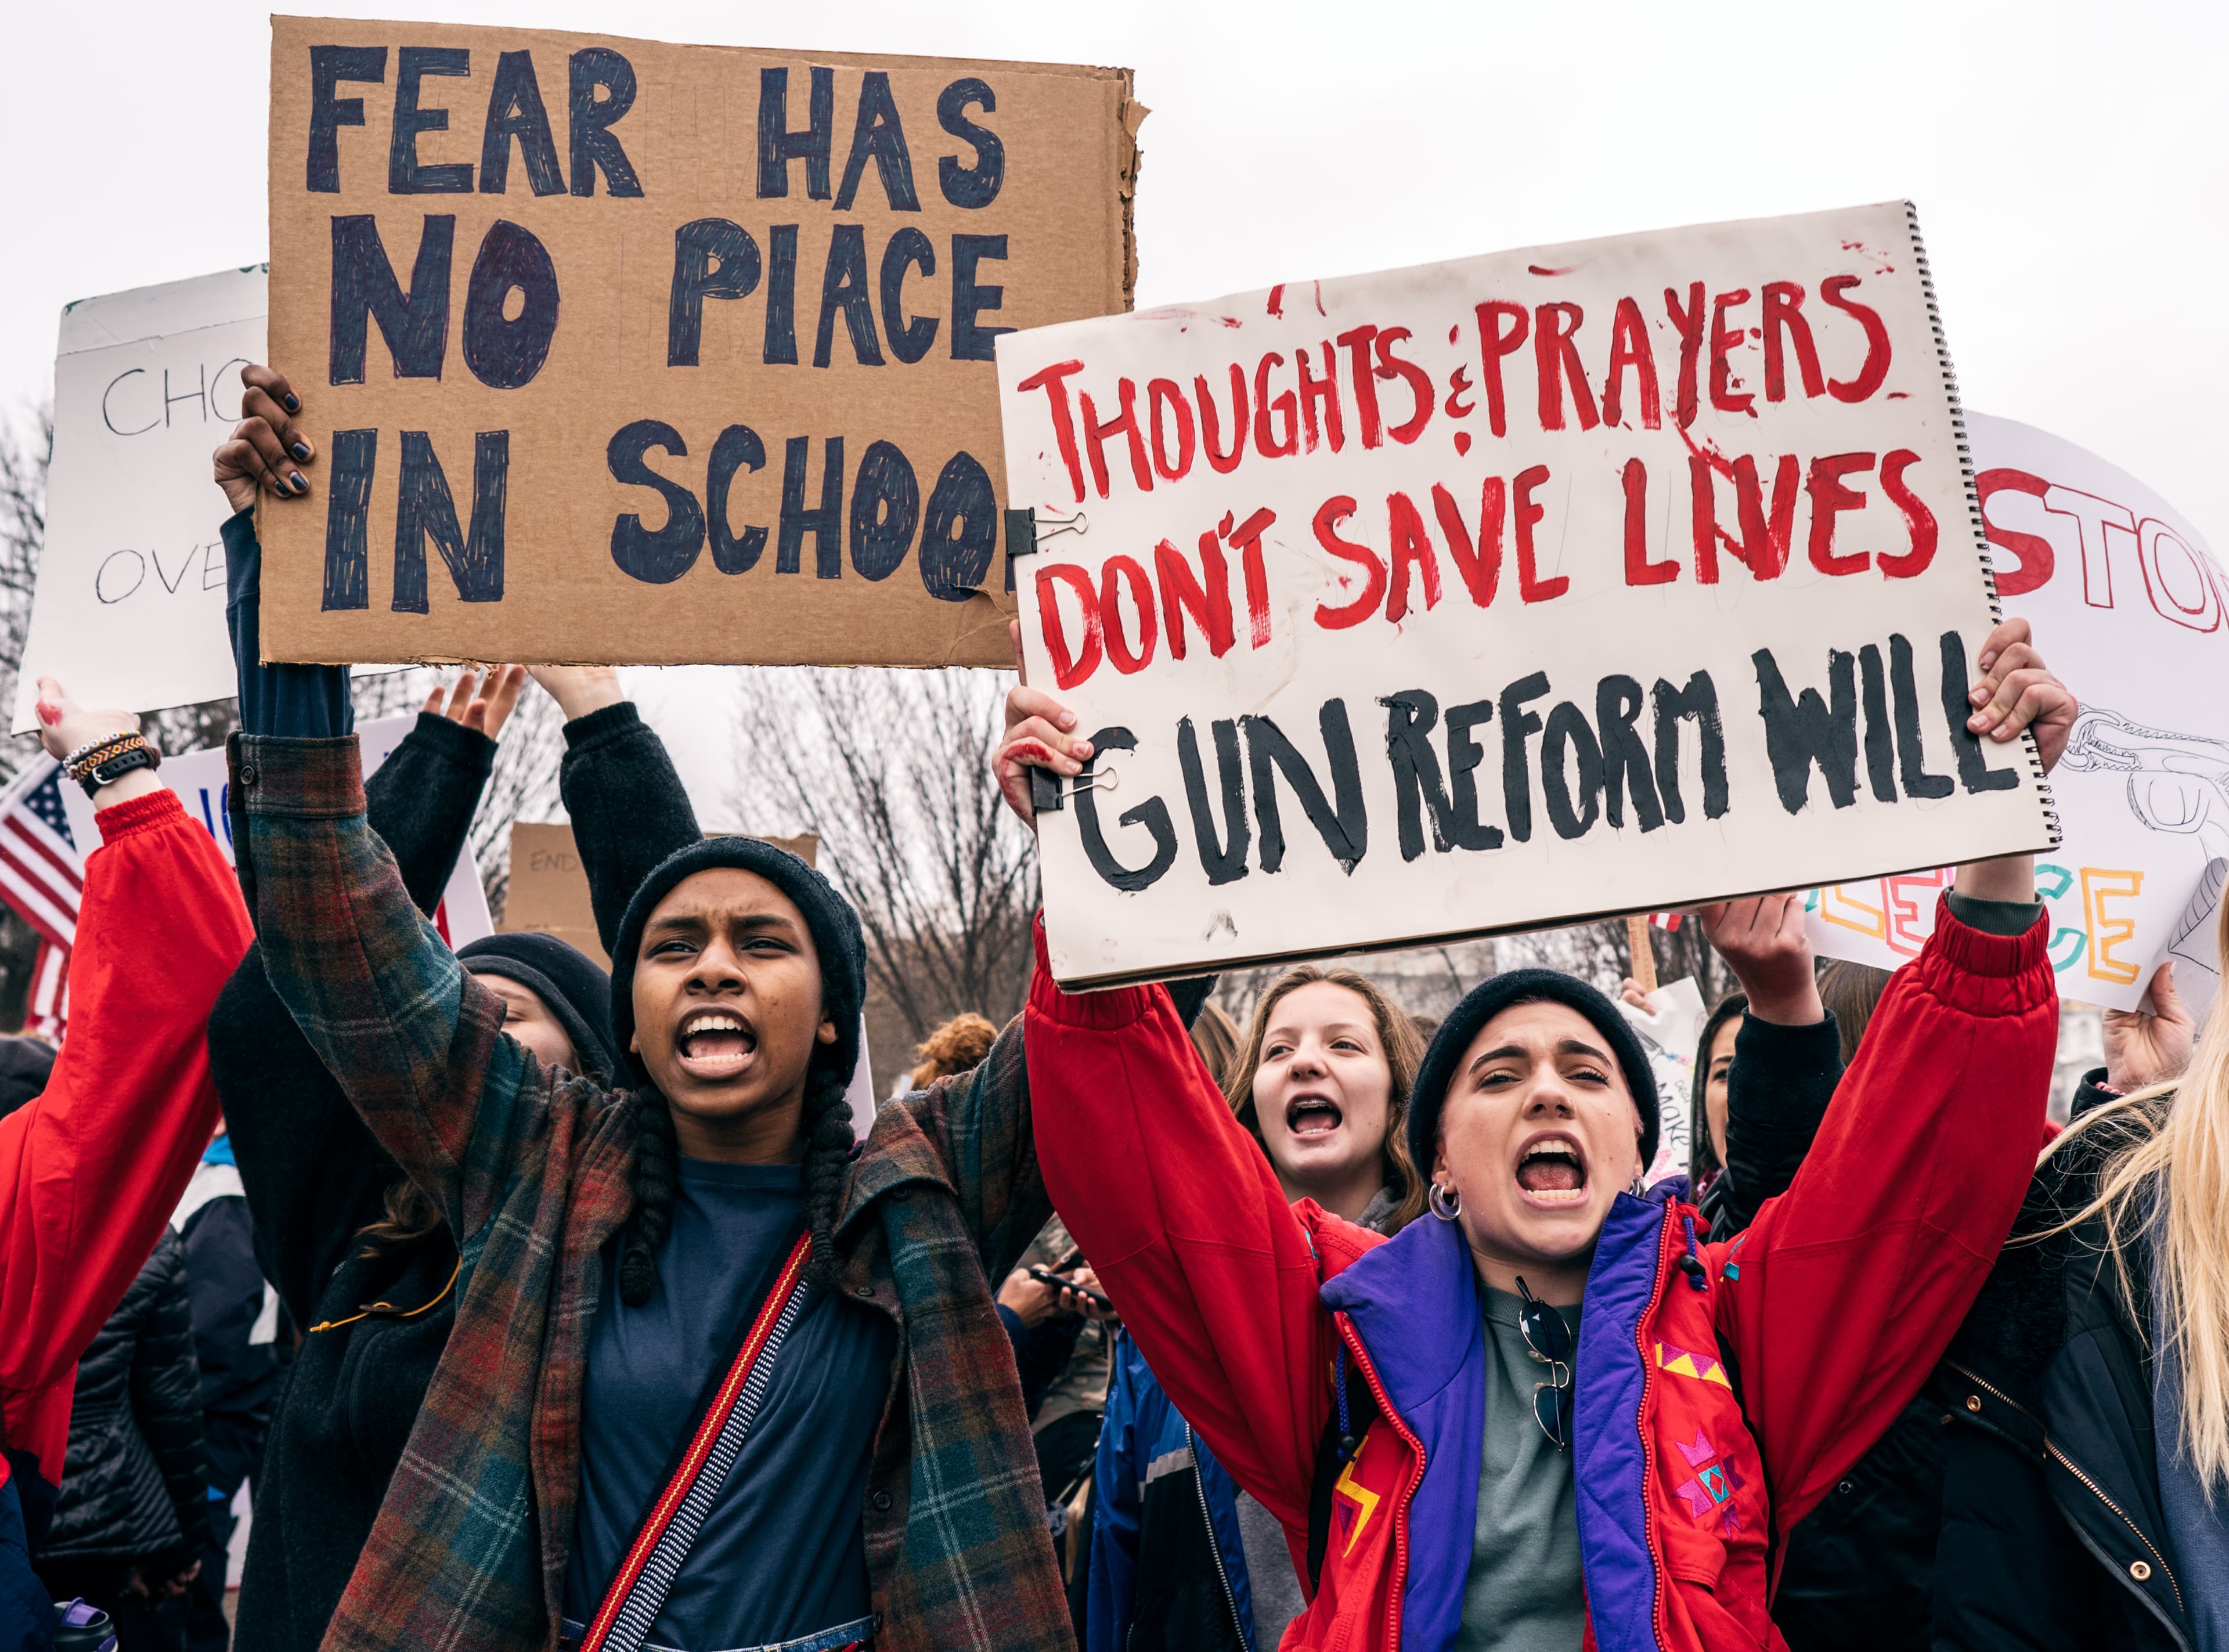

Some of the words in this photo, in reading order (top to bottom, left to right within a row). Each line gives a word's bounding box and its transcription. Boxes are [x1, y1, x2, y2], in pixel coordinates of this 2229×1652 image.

[307, 46, 643, 197] FEAR
[757, 67, 1004, 211] HAS
[330, 215, 560, 389] NO
[103, 358, 253, 436] CHO
[1017, 324, 1434, 503] THOUGHTS
[1445, 324, 1476, 457] &
[1478, 275, 1892, 438] PRAYERS
[96, 540, 226, 604] OVE
[322, 429, 508, 614] IN
[608, 420, 1016, 601] SCHOO
[1035, 507, 1276, 691] DON'T
[1312, 464, 1570, 630] SAVE
[1622, 449, 1938, 586] LIVES
[1974, 468, 2229, 633] STO
[1074, 698, 1367, 892] GUN
[1380, 669, 1729, 862] REFORM
[1751, 631, 2019, 815] WILL
[531, 849, 579, 873] END
